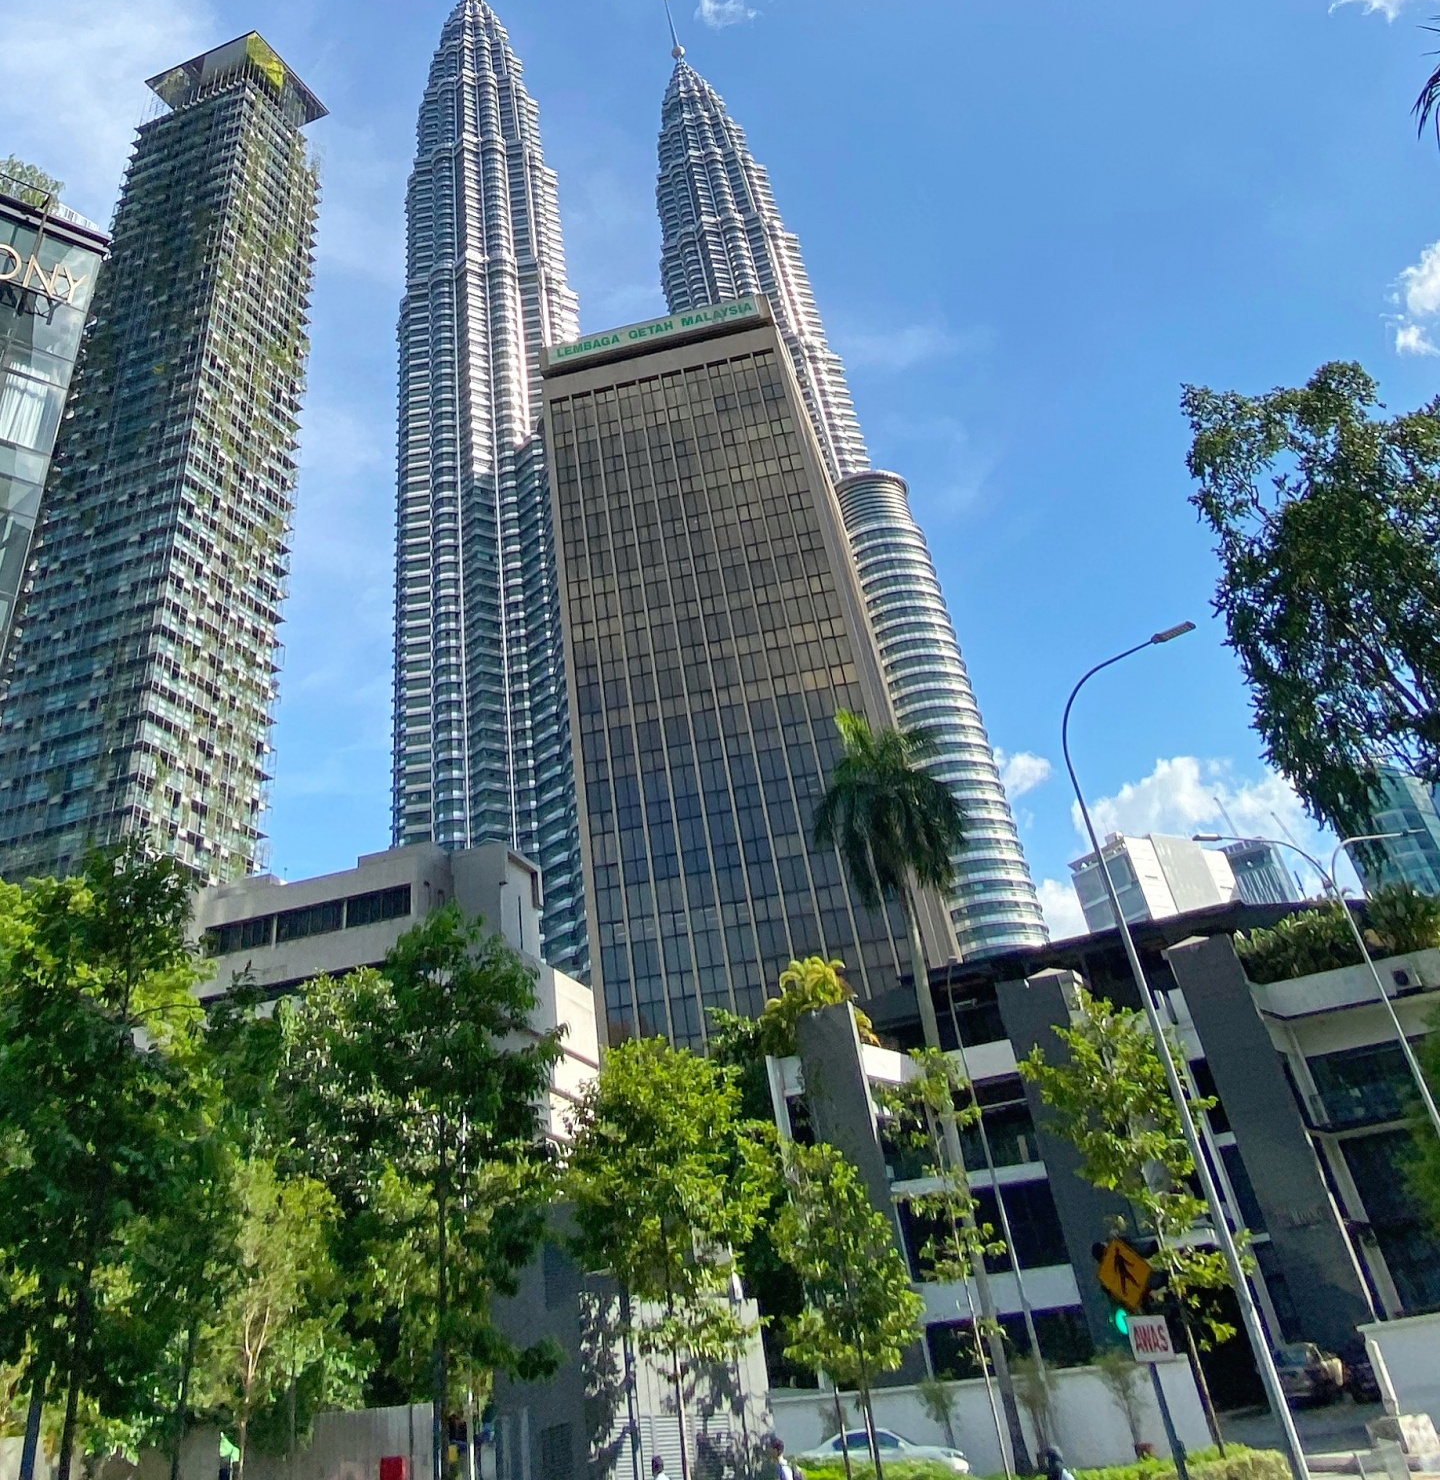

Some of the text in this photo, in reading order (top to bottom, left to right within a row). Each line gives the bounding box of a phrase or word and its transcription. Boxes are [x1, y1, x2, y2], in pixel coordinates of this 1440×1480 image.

[557, 303, 752, 358] LEMBAGA GETAH MALAYSIA
[1133, 1324, 1169, 1353] AWAS
